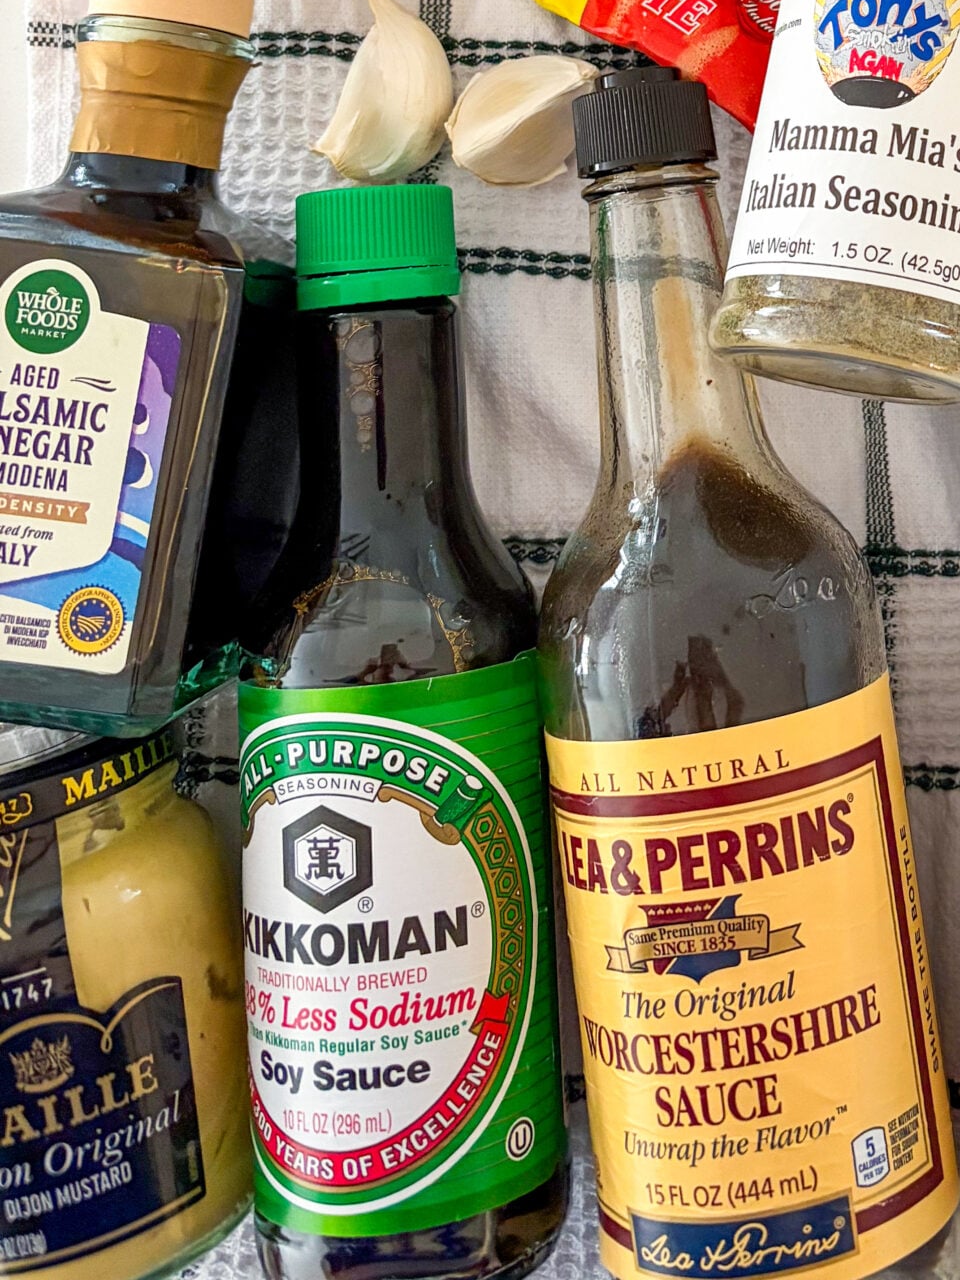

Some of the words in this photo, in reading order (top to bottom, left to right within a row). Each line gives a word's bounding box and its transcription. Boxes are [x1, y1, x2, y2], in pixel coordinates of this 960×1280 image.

[768, 118, 877, 155] Mamma
[745, 173, 817, 213] Italian
[747, 238, 764, 255] Net
[767, 236, 816, 258] Weight:
[831, 241, 858, 259] 1.5
[863, 244, 894, 266] OZ.
[15, 308, 79, 331] FOODS
[16, 288, 84, 315] WHOLE
[21, 327, 67, 339] MARKET
[10, 363, 60, 389] AGED
[20, 525, 53, 540] from
[62, 732, 174, 806] MAILLE
[243, 739, 450, 798] ALL-PURPOSE
[278, 776, 376, 796] SEASONING
[580, 772, 621, 793] ALL
[638, 749, 790, 792] NATURAL
[244, 905, 468, 966] KIKKOMAN
[628, 928, 658, 946] Same
[659, 923, 717, 942] Premium
[717, 918, 765, 938] Quality
[653, 938, 696, 957] SINCE
[701, 935, 736, 952] 1835
[2, 978, 53, 1011] 1747
[258, 967, 350, 992] TRADITIONALLY
[357, 966, 427, 991] BREWED
[622, 990, 666, 1020] The
[674, 970, 796, 1022] Original
[281, 995, 337, 1032] Less
[349, 987, 477, 1031] Sodium
[583, 984, 881, 1076] WORCESTERSHIRE
[922, 987, 939, 1074] SHAKE
[264, 1029, 315, 1053] Kikkoman
[320, 1039, 375, 1057] Regular
[381, 1034, 409, 1052] Soy
[261, 1049, 304, 1094] Soy
[313, 1059, 431, 1092] Sauce
[274, 1134, 334, 1182] YEARS
[342, 1154, 373, 1180] OF
[380, 1030, 503, 1169] EXCELLENCE
[655, 1074, 782, 1128] SAUCE
[44, 1089, 181, 1177] Original
[283, 1108, 294, 1128] 10
[297, 1111, 310, 1134] FL
[313, 1112, 329, 1135] OZ
[332, 1110, 362, 1138] (296
[365, 1108, 392, 1135] mL)
[624, 1130, 706, 1167] Unwrap
[711, 1134, 749, 1159] the
[755, 1116, 836, 1153] Flavor
[4, 1188, 54, 1224] DIJON
[55, 1161, 133, 1210] MUSTARD
[645, 1182, 665, 1205] 15
[669, 1185, 690, 1207] FL
[694, 1184, 722, 1208] OZ
[728, 1183, 775, 1209] (444
[780, 1165, 819, 1195] mL)
